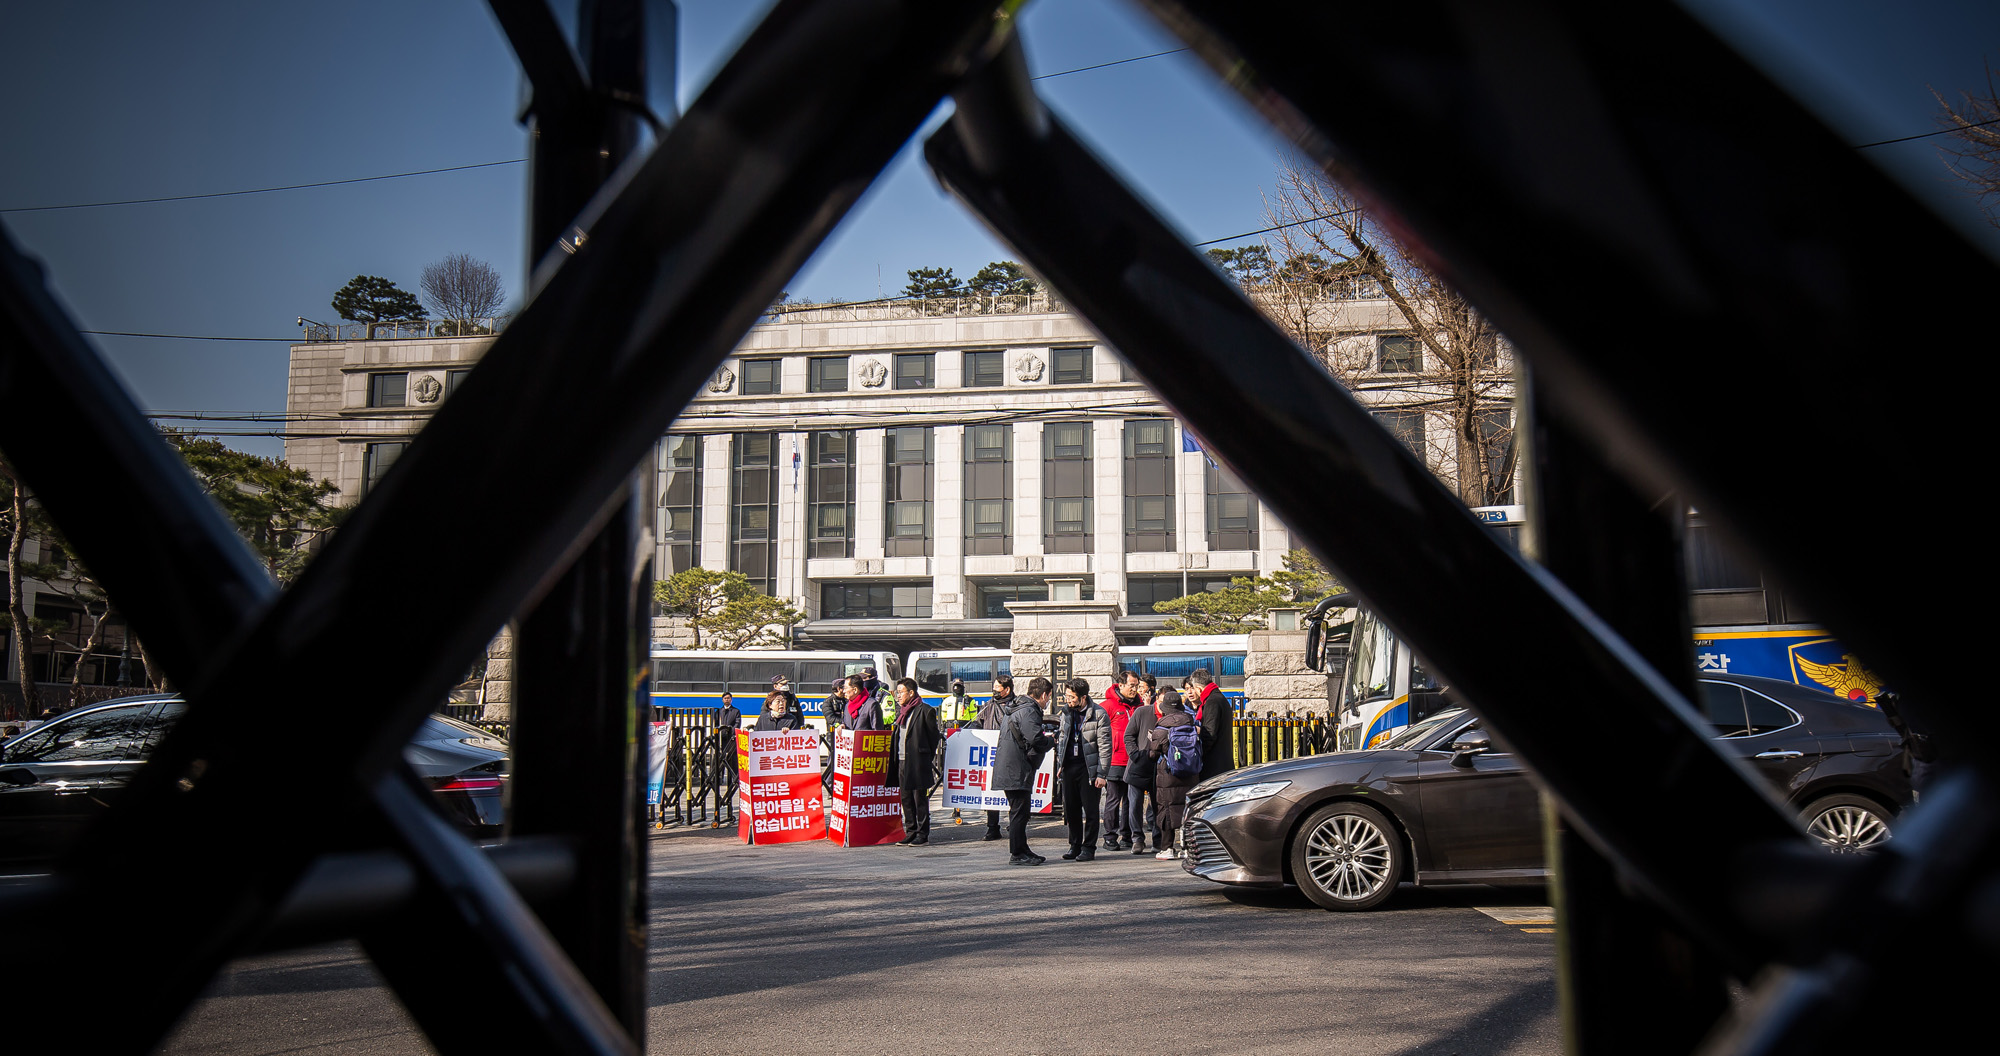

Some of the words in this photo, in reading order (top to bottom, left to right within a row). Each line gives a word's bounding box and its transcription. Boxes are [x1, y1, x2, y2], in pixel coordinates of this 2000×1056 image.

[1056, 655, 1068, 715] 헌법재판
[752, 736, 817, 752] 헌법재판소
[759, 754, 811, 770] 졸속심판
[853, 757, 889, 775] 탄핵기
[947, 768, 987, 791] 탄핵
[752, 782, 790, 797] 국민은
[851, 785, 875, 798] 국민의
[753, 799, 805, 815] 받아들일
[807, 797, 821, 811] 수
[951, 795, 982, 805] 탄핵반대
[984, 796, 1010, 807] 당협위
[850, 803, 901, 818] 목소리입니다
[754, 815, 810, 834] 없습니다!
